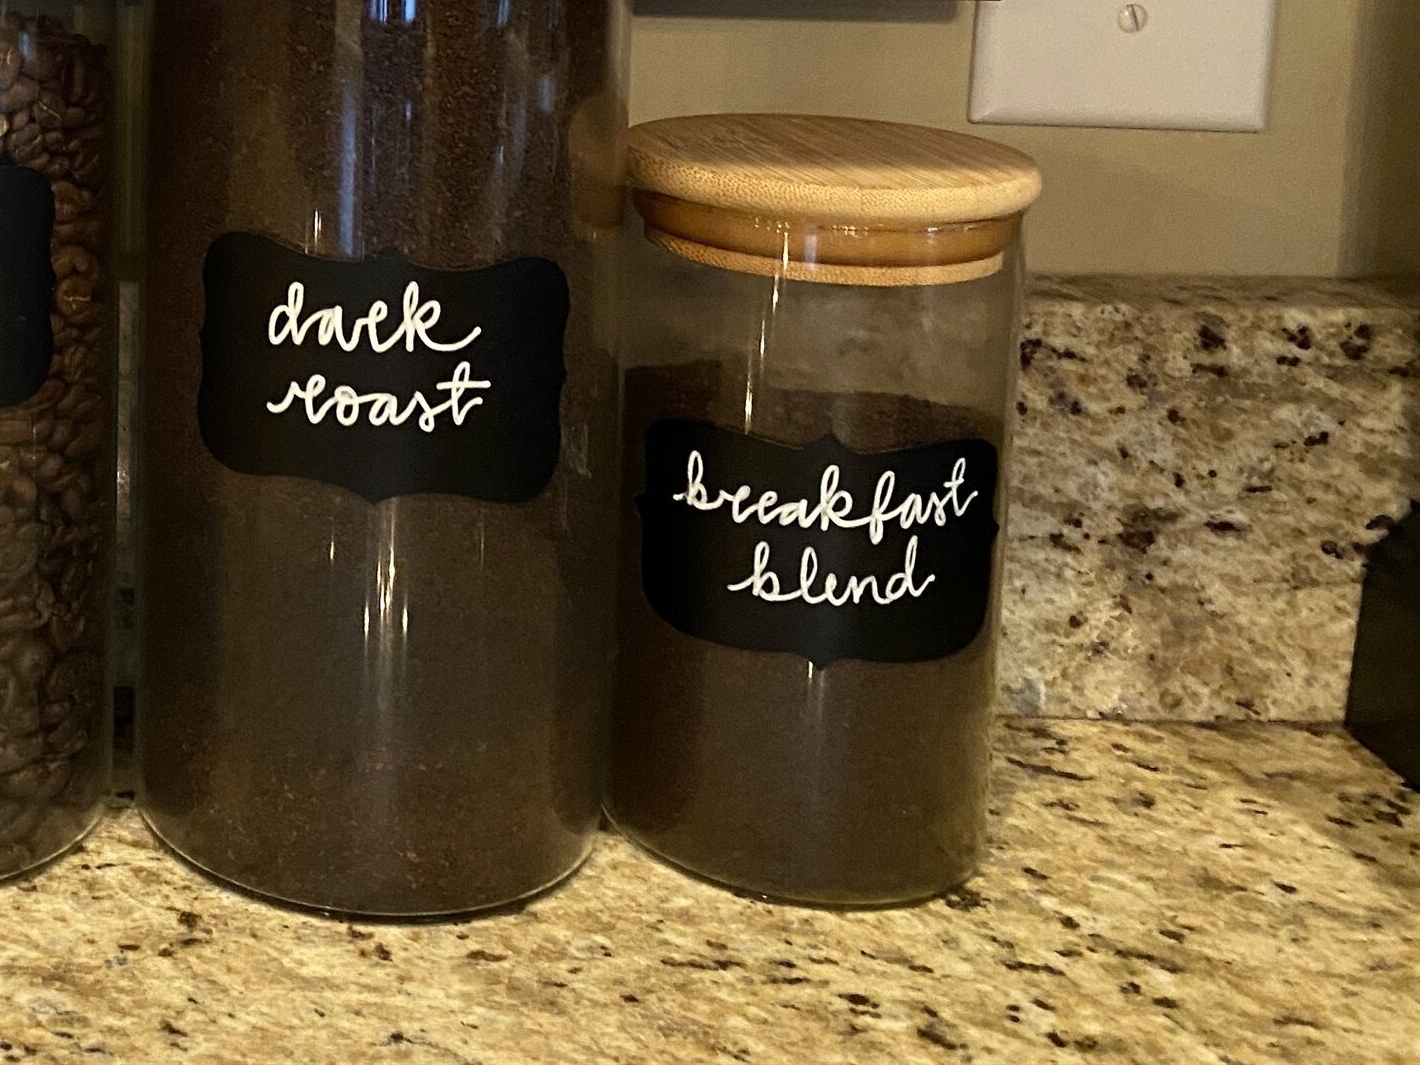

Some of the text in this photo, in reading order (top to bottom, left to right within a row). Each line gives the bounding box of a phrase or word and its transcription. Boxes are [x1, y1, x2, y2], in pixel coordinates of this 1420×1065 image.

[268, 280, 482, 353] dark
[266, 361, 492, 433] roast
[672, 450, 979, 545] breakfast
[726, 534, 936, 607] blend
